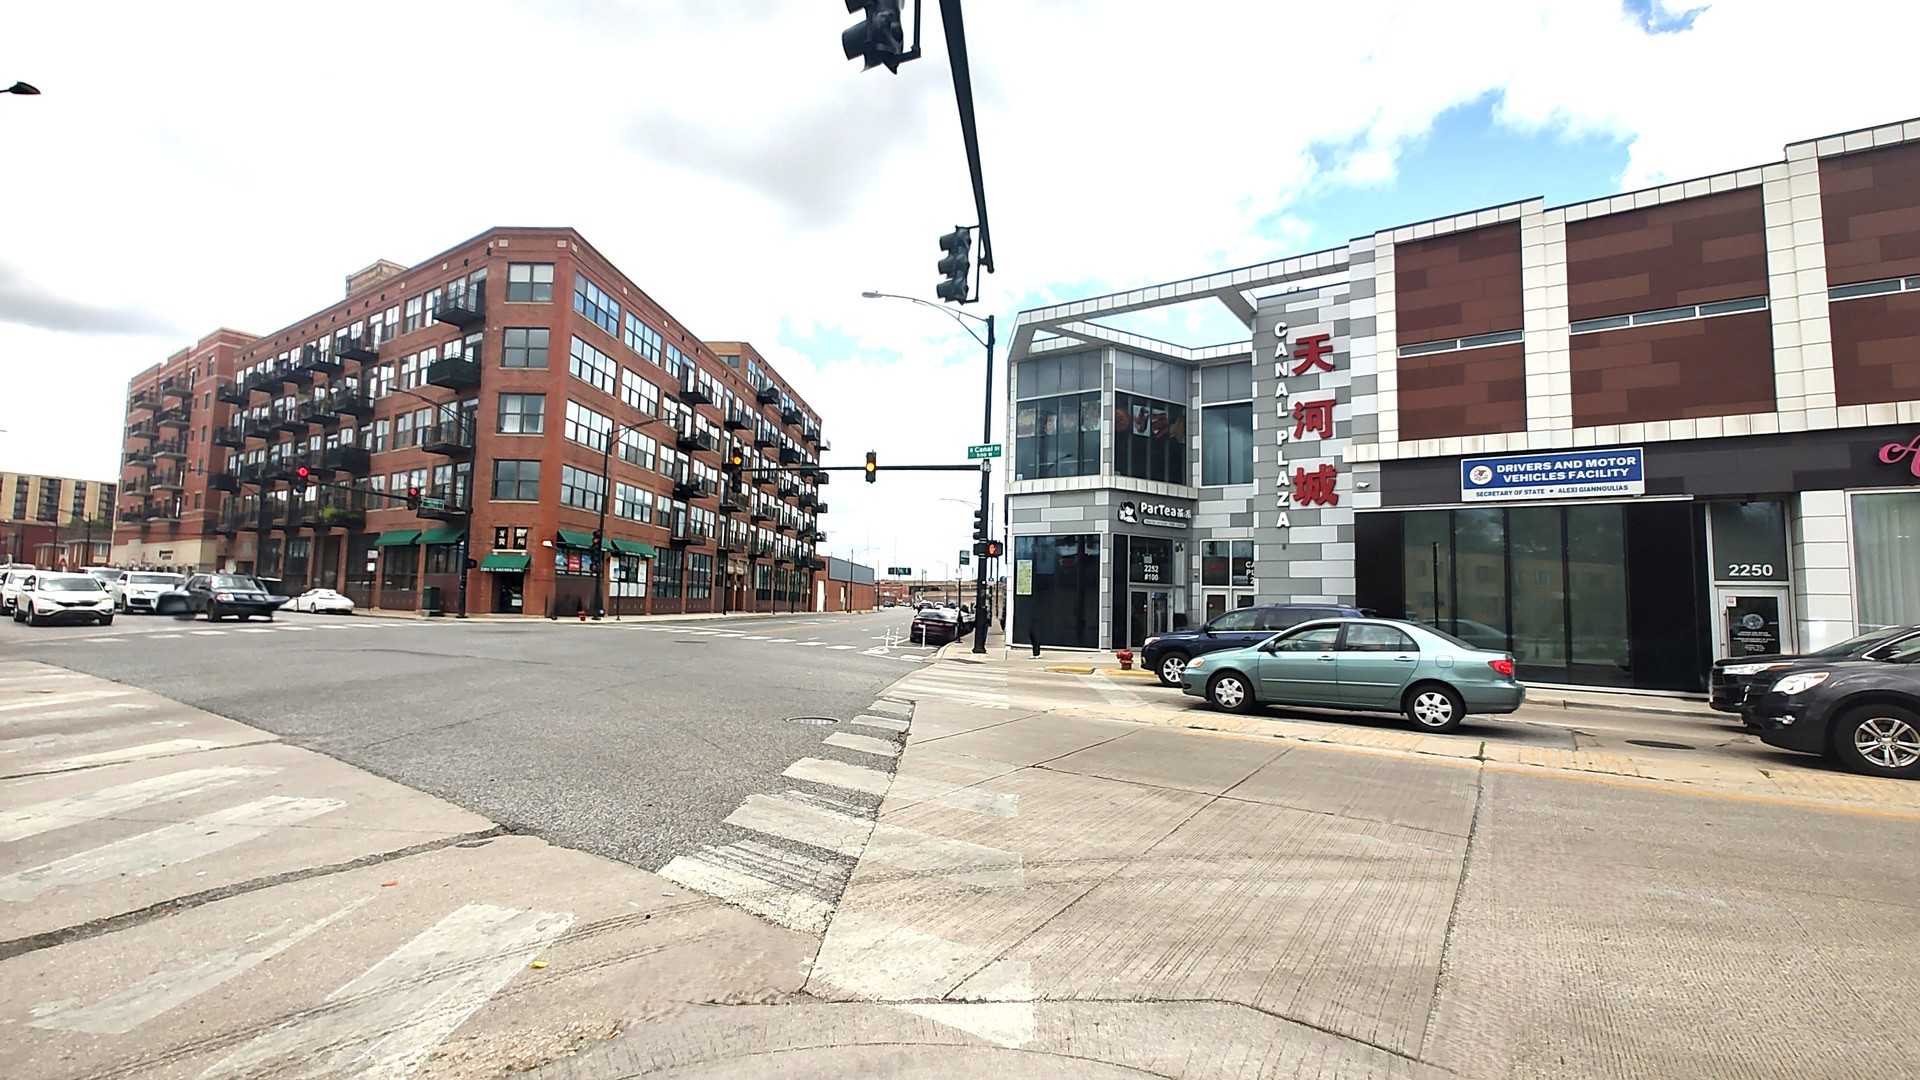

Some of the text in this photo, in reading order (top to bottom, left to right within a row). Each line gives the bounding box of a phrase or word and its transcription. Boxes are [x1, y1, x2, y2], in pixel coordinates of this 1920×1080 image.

[1274, 321, 1290, 528] CANAL PLAZA
[1292, 333, 1339, 506] 天河城
[1496, 456, 1636, 473] DRIVERS AND MOTOR
[1503, 468, 1630, 483] VEHICLES FACILITY
[1558, 486, 1578, 494] ALEXI
[1578, 485, 1629, 493] GIANNOULIAS
[1140, 502, 1177, 517] ParTea
[1143, 564, 1159, 573] 2252
[1728, 564, 1773, 577] 2250
